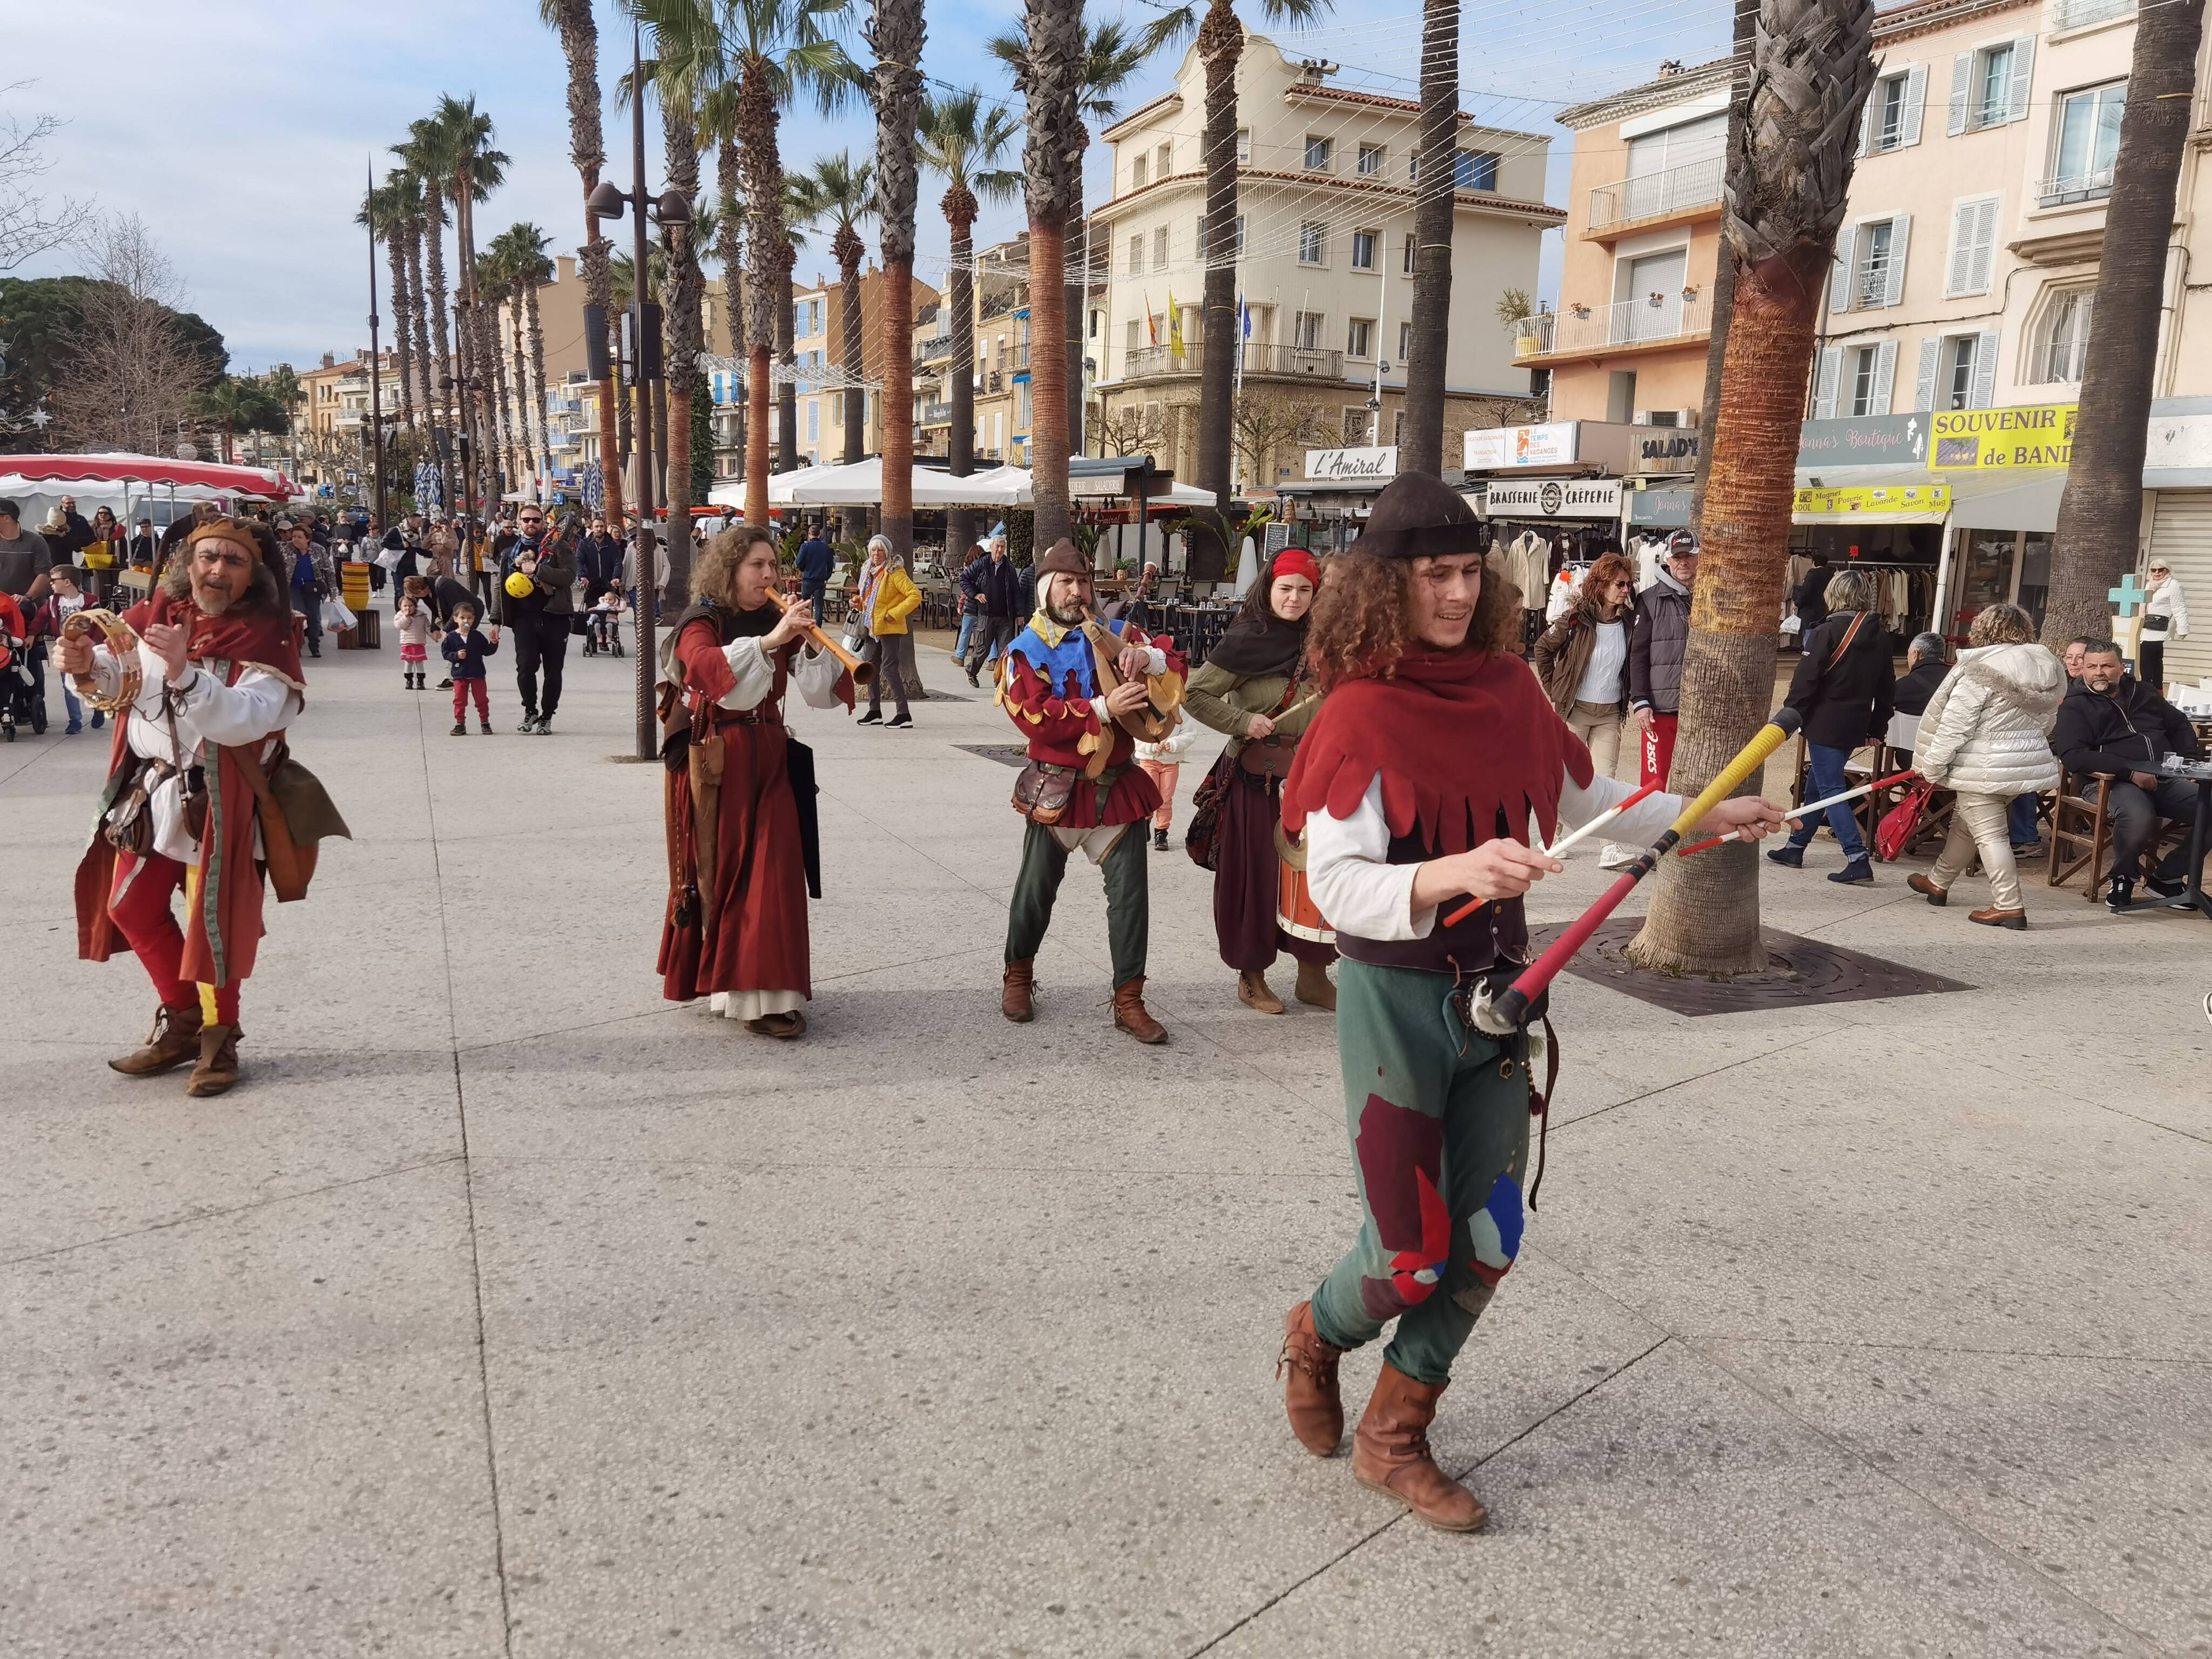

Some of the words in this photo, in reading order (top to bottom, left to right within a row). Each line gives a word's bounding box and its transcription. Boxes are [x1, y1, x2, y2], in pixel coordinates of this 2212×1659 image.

[1936, 410, 2056, 434] SOUVENIR
[1530, 434, 1549, 442] TEMPS
[1799, 430, 1839, 450] onna's
[1845, 429, 1904, 453] Boutique
[1530, 447, 1558, 455] VACANCES
[1984, 448, 2006, 466] de
[1314, 451, 1386, 475] L'Amiral
[1490, 491, 1538, 505] BRASSERIE
[1815, 490, 1842, 500] Magnet
[1838, 494, 1863, 504] Poterie
[1866, 496, 1898, 508] Lavande
[1900, 499, 1924, 508] Savon
[1929, 499, 1946, 509] Mug
